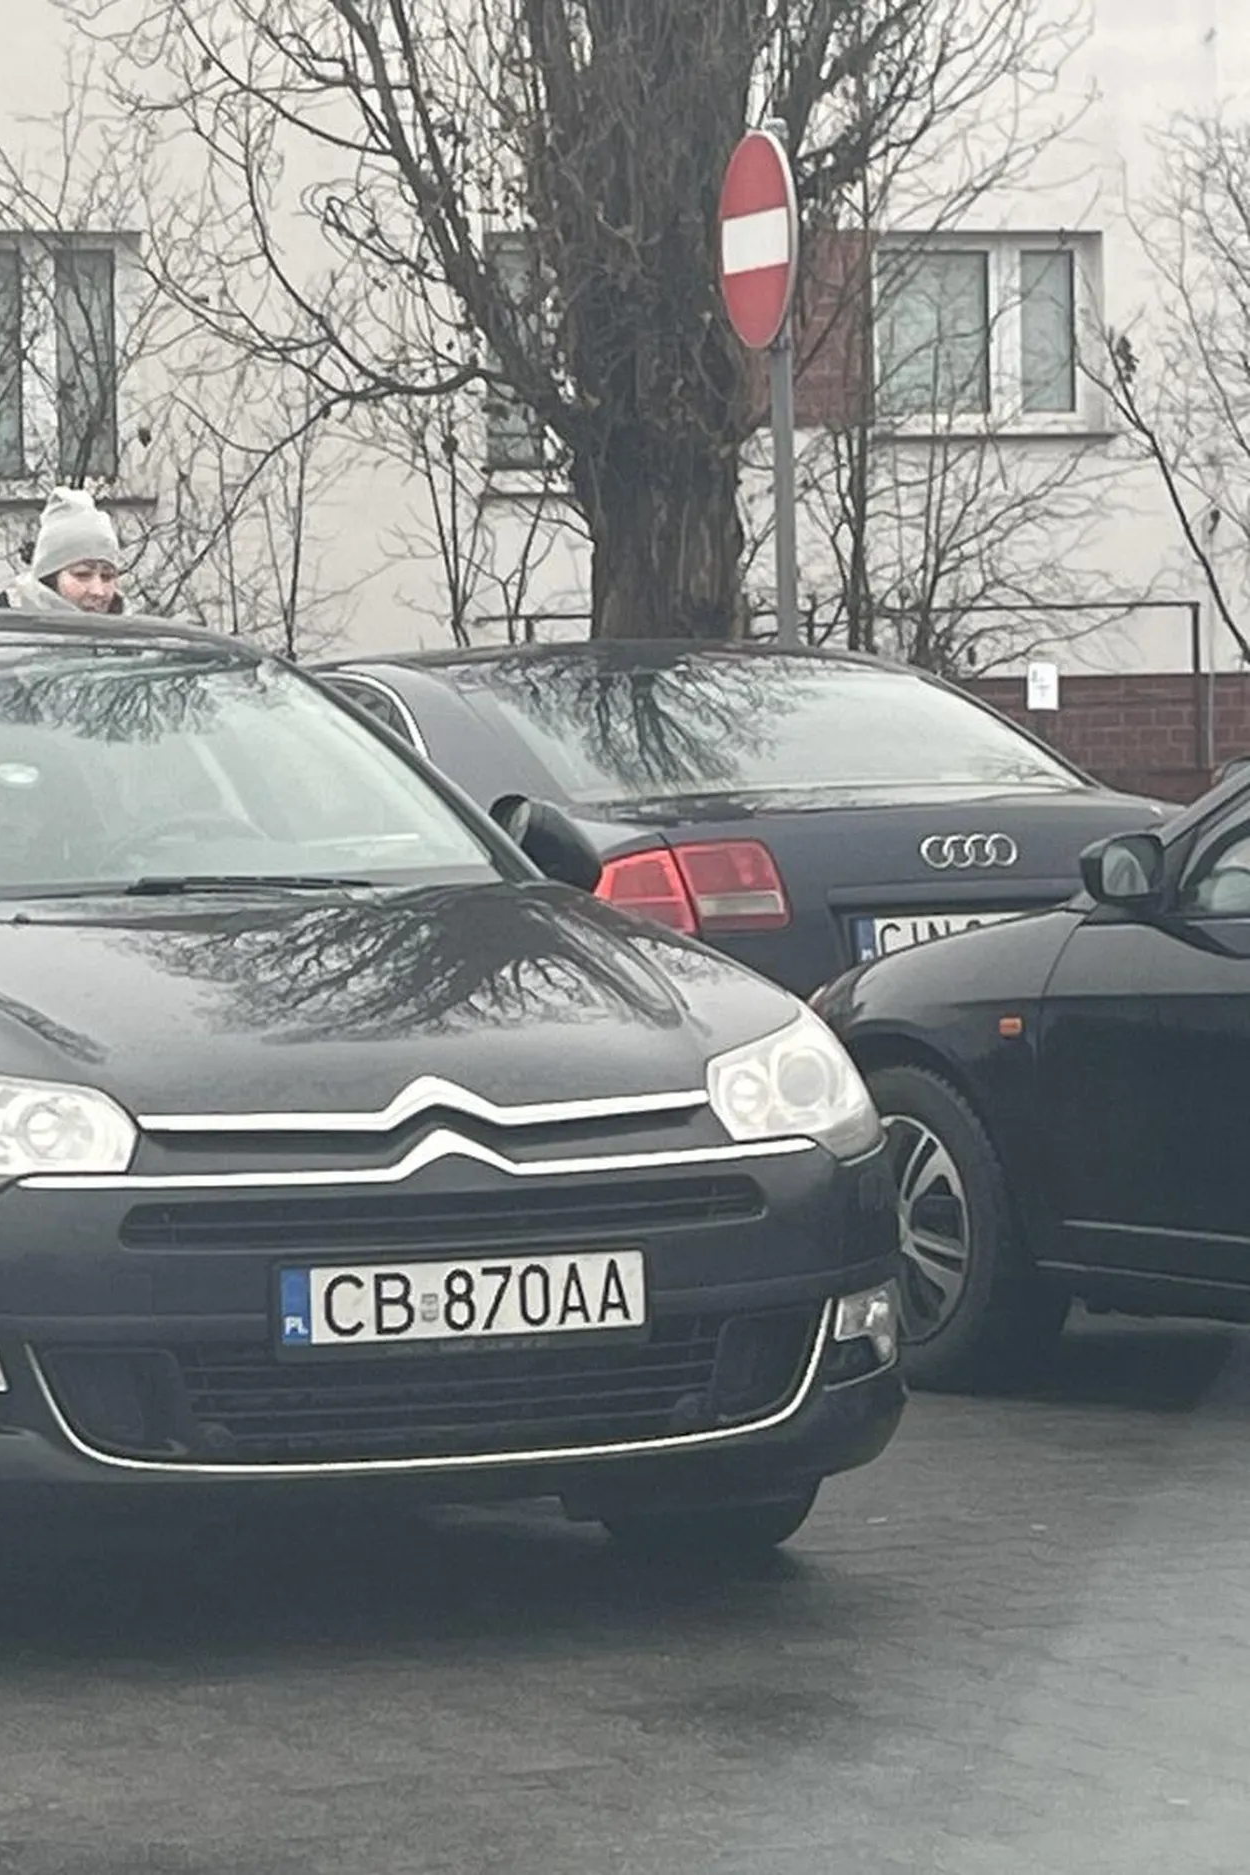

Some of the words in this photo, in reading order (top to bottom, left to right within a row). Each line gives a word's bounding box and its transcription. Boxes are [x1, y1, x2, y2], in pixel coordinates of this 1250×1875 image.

[324, 1273, 415, 1337] CB
[443, 1258, 631, 1331] 870AA
[284, 1315, 309, 1335] PL
